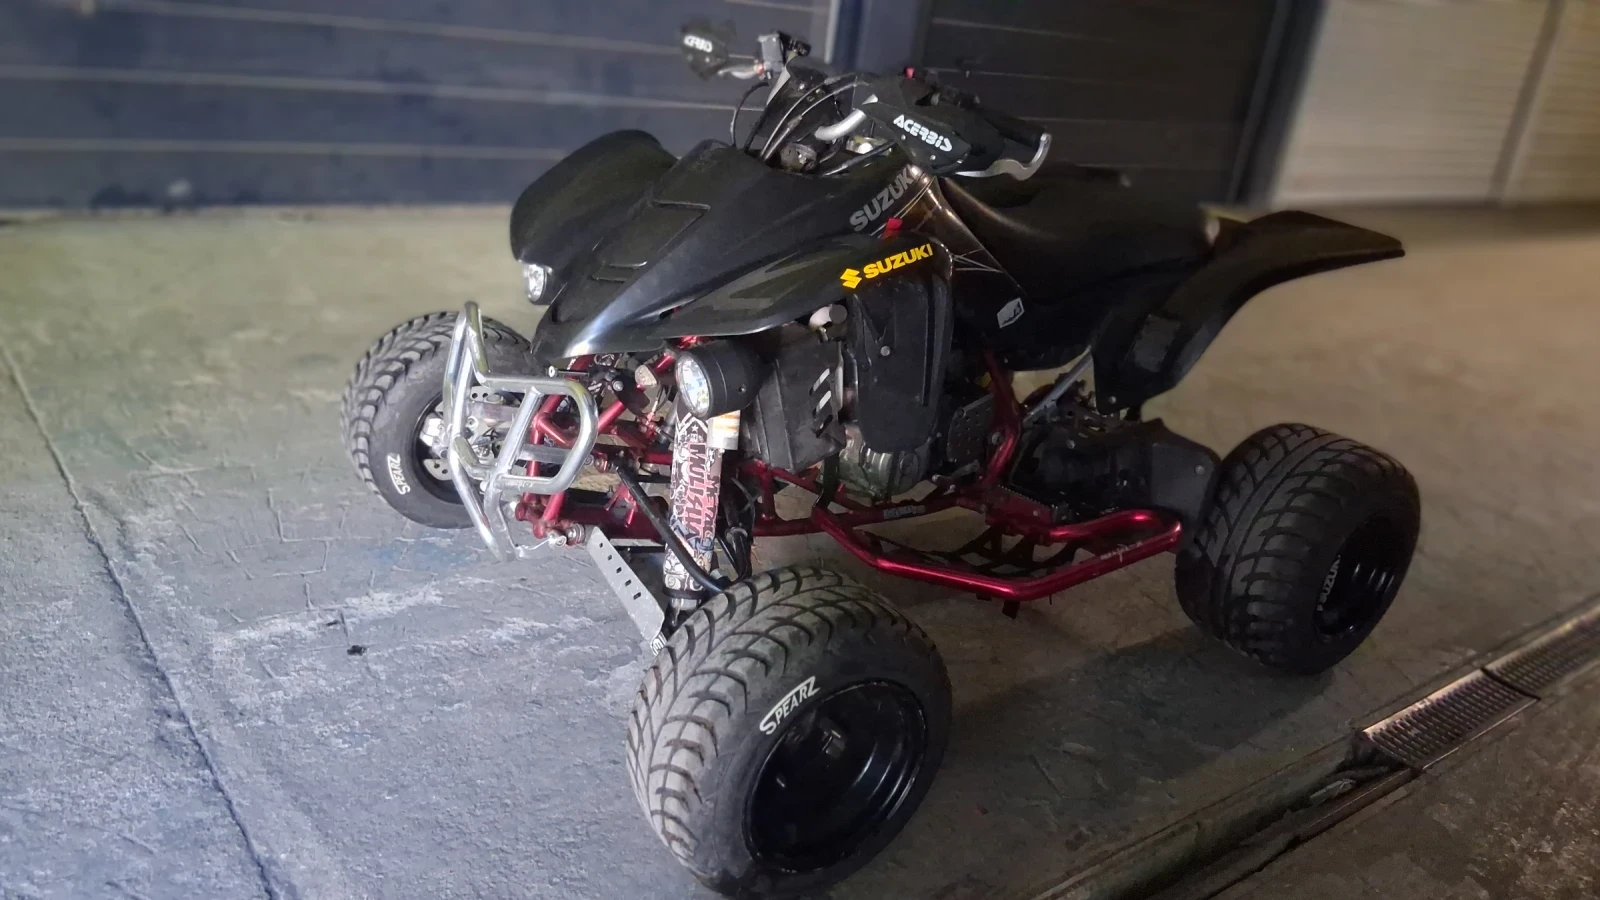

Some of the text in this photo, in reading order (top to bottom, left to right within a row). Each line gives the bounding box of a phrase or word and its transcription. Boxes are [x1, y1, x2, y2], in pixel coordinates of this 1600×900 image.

[893, 114, 952, 152] ACERBIS
[863, 243, 933, 279] SUZUKI
[387, 453, 411, 495] SPEARZ
[1319, 554, 1341, 604] SUZUK
[759, 675, 821, 735] SPEARZ
